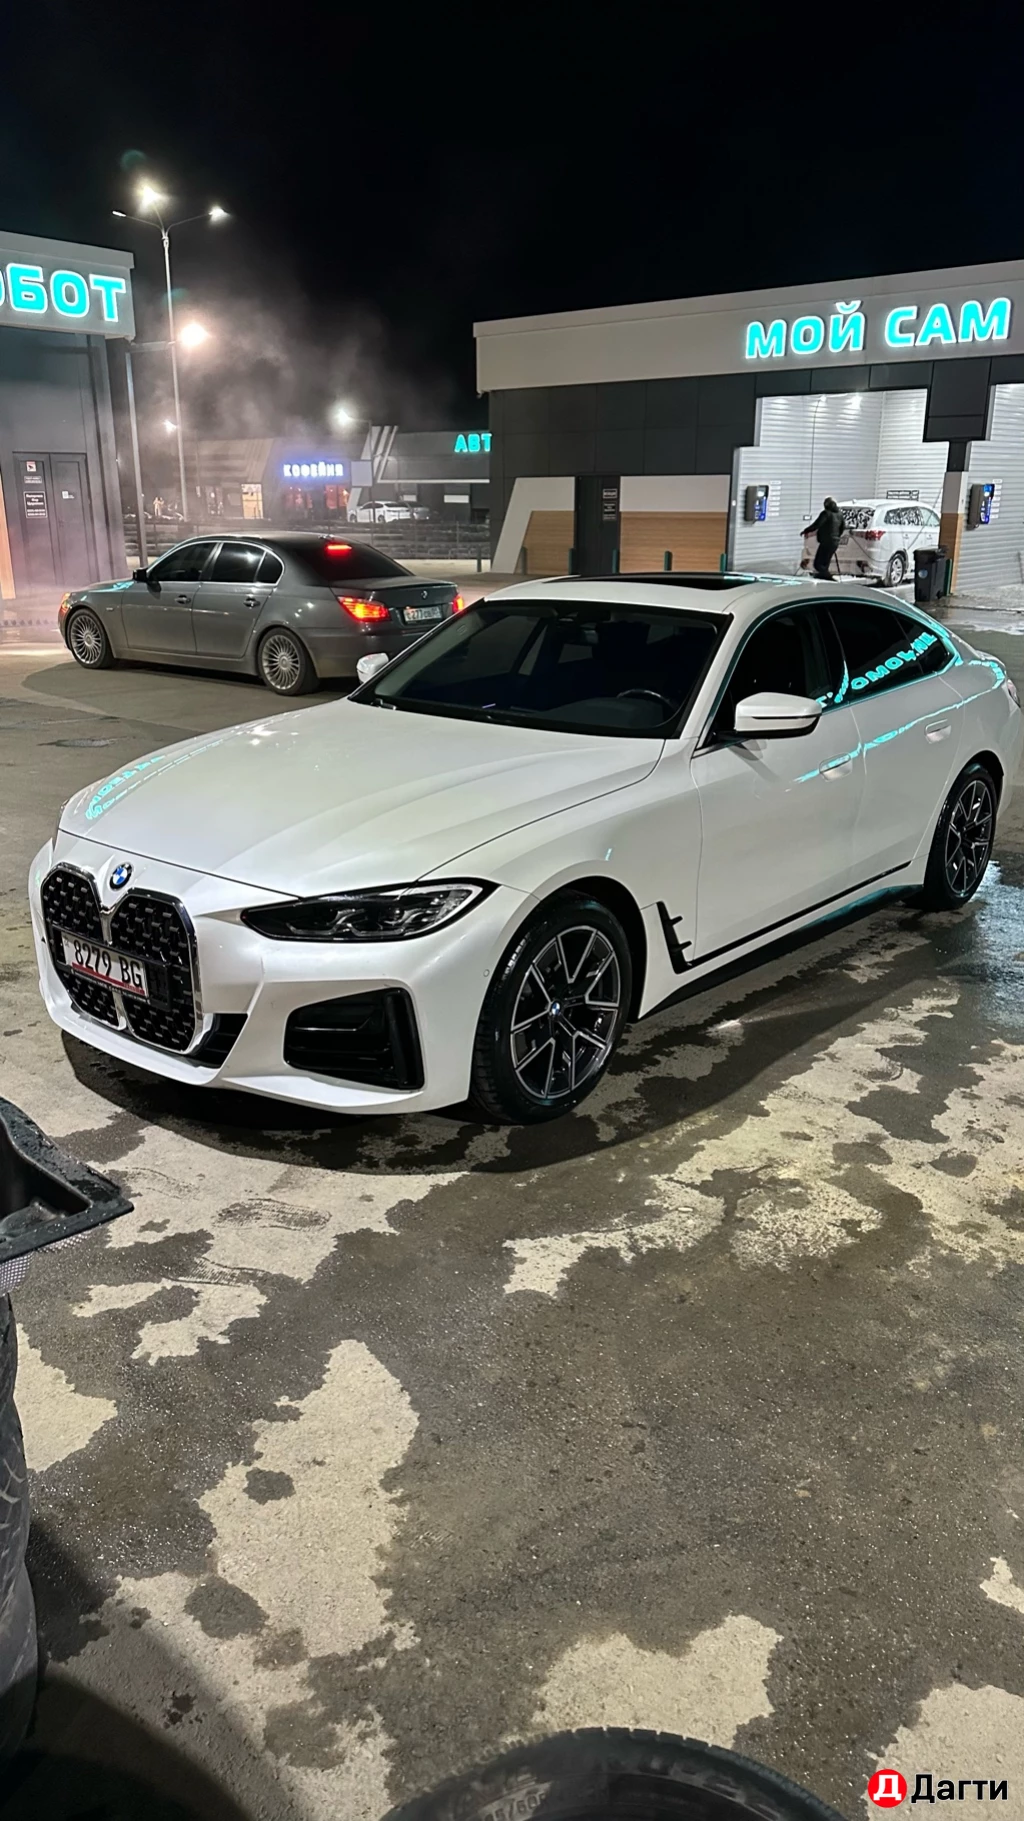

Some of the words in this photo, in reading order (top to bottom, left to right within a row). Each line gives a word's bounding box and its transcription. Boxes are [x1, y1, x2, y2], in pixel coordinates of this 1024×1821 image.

[0, 262, 127, 323] БОТ
[744, 299, 866, 360] МОЙ
[884, 296, 1012, 348] САМ
[283, 461, 344, 478] КОФЕЙНЯ
[73, 939, 112, 977] 8279
[118, 955, 144, 989] BG
